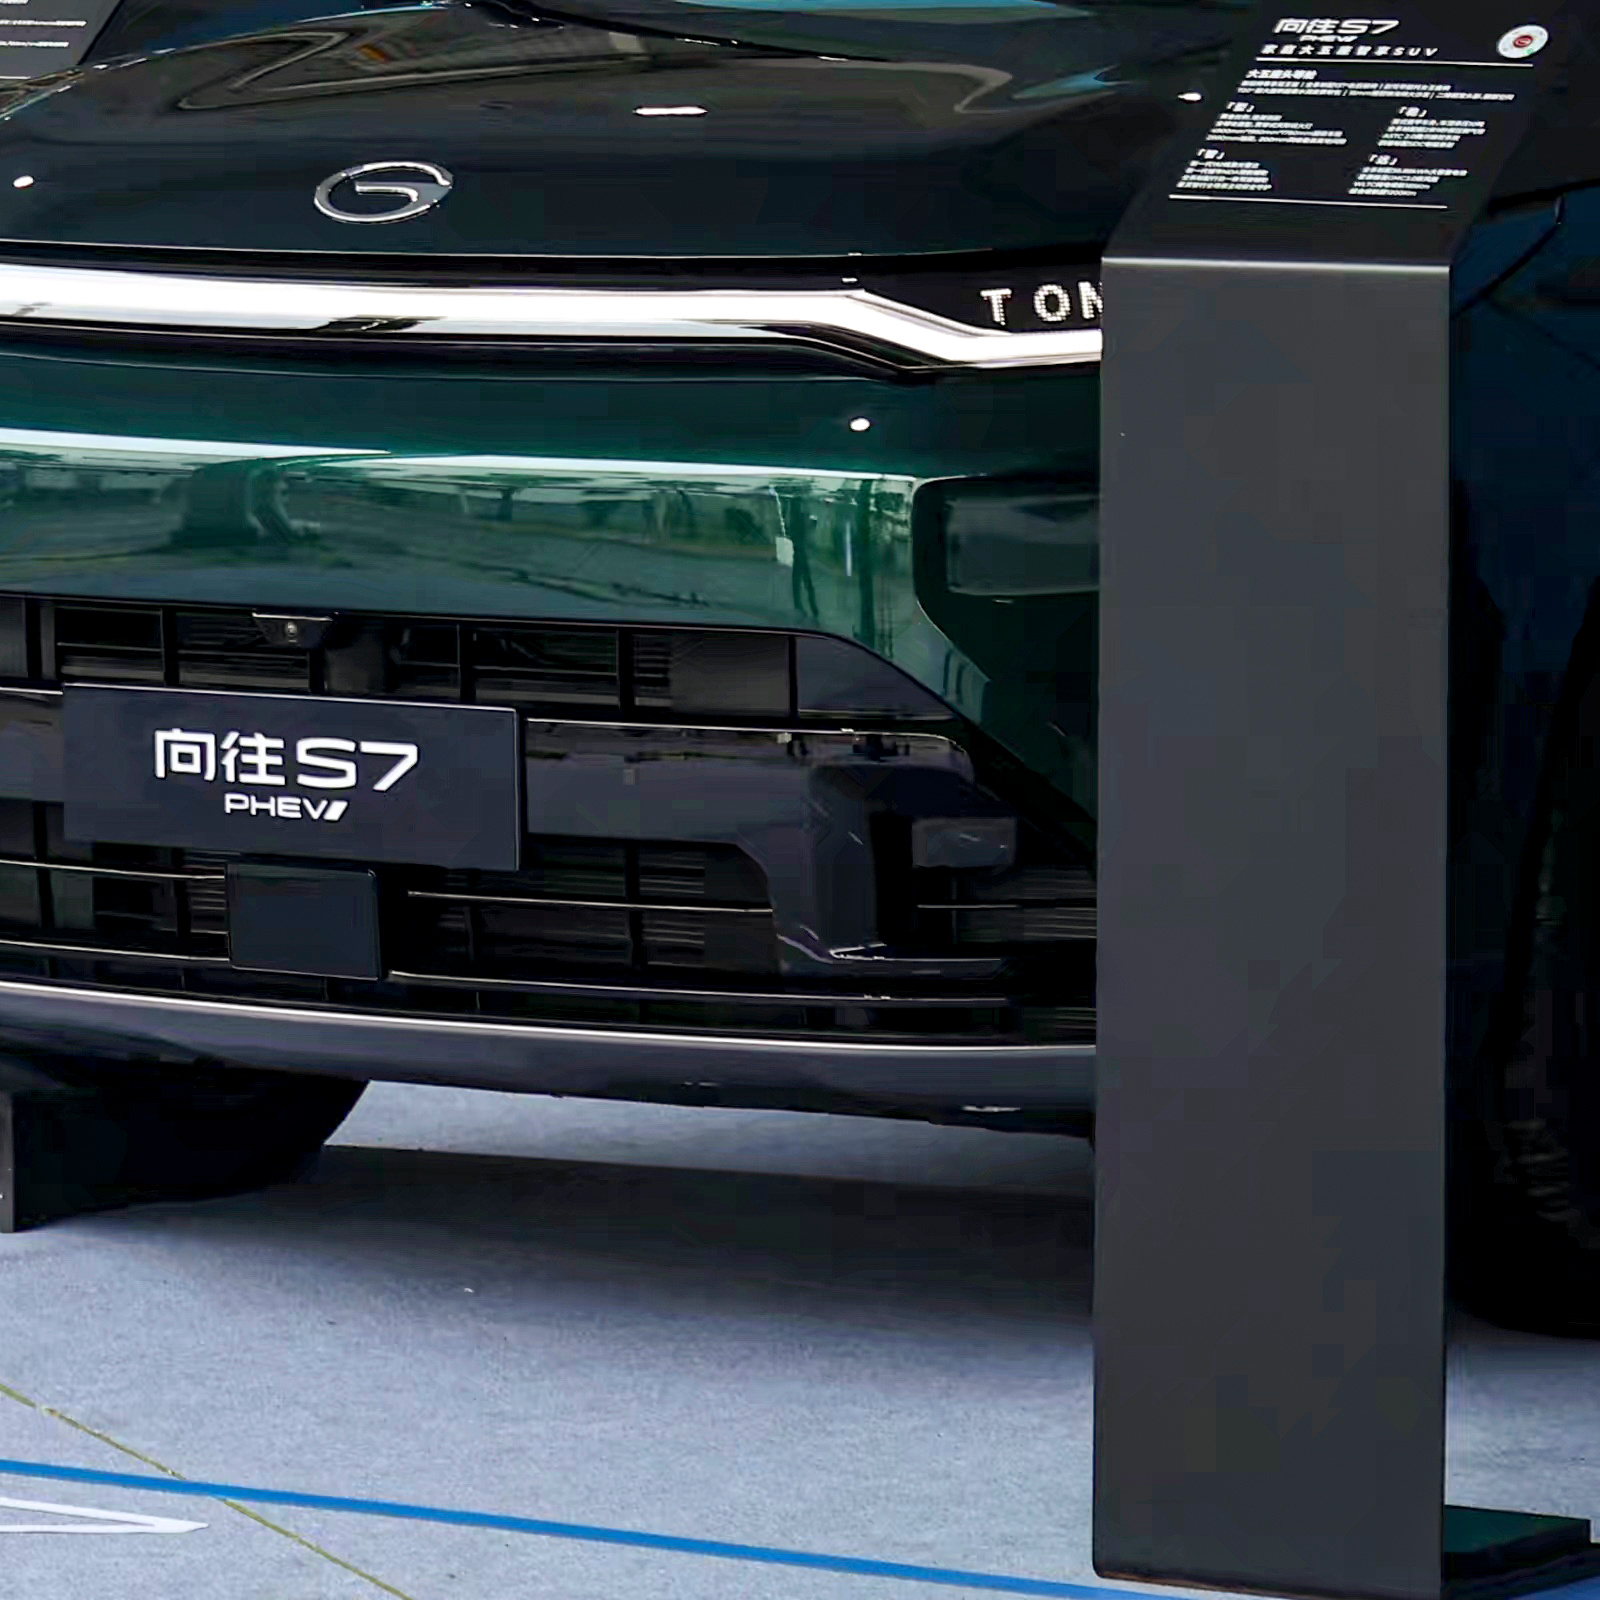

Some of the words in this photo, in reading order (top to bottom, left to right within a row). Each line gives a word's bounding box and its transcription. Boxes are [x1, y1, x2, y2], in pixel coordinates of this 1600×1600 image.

[1273, 18, 1400, 35] 向往S7
[153, 727, 420, 792] 向往S7
[224, 792, 349, 823] PHEV
